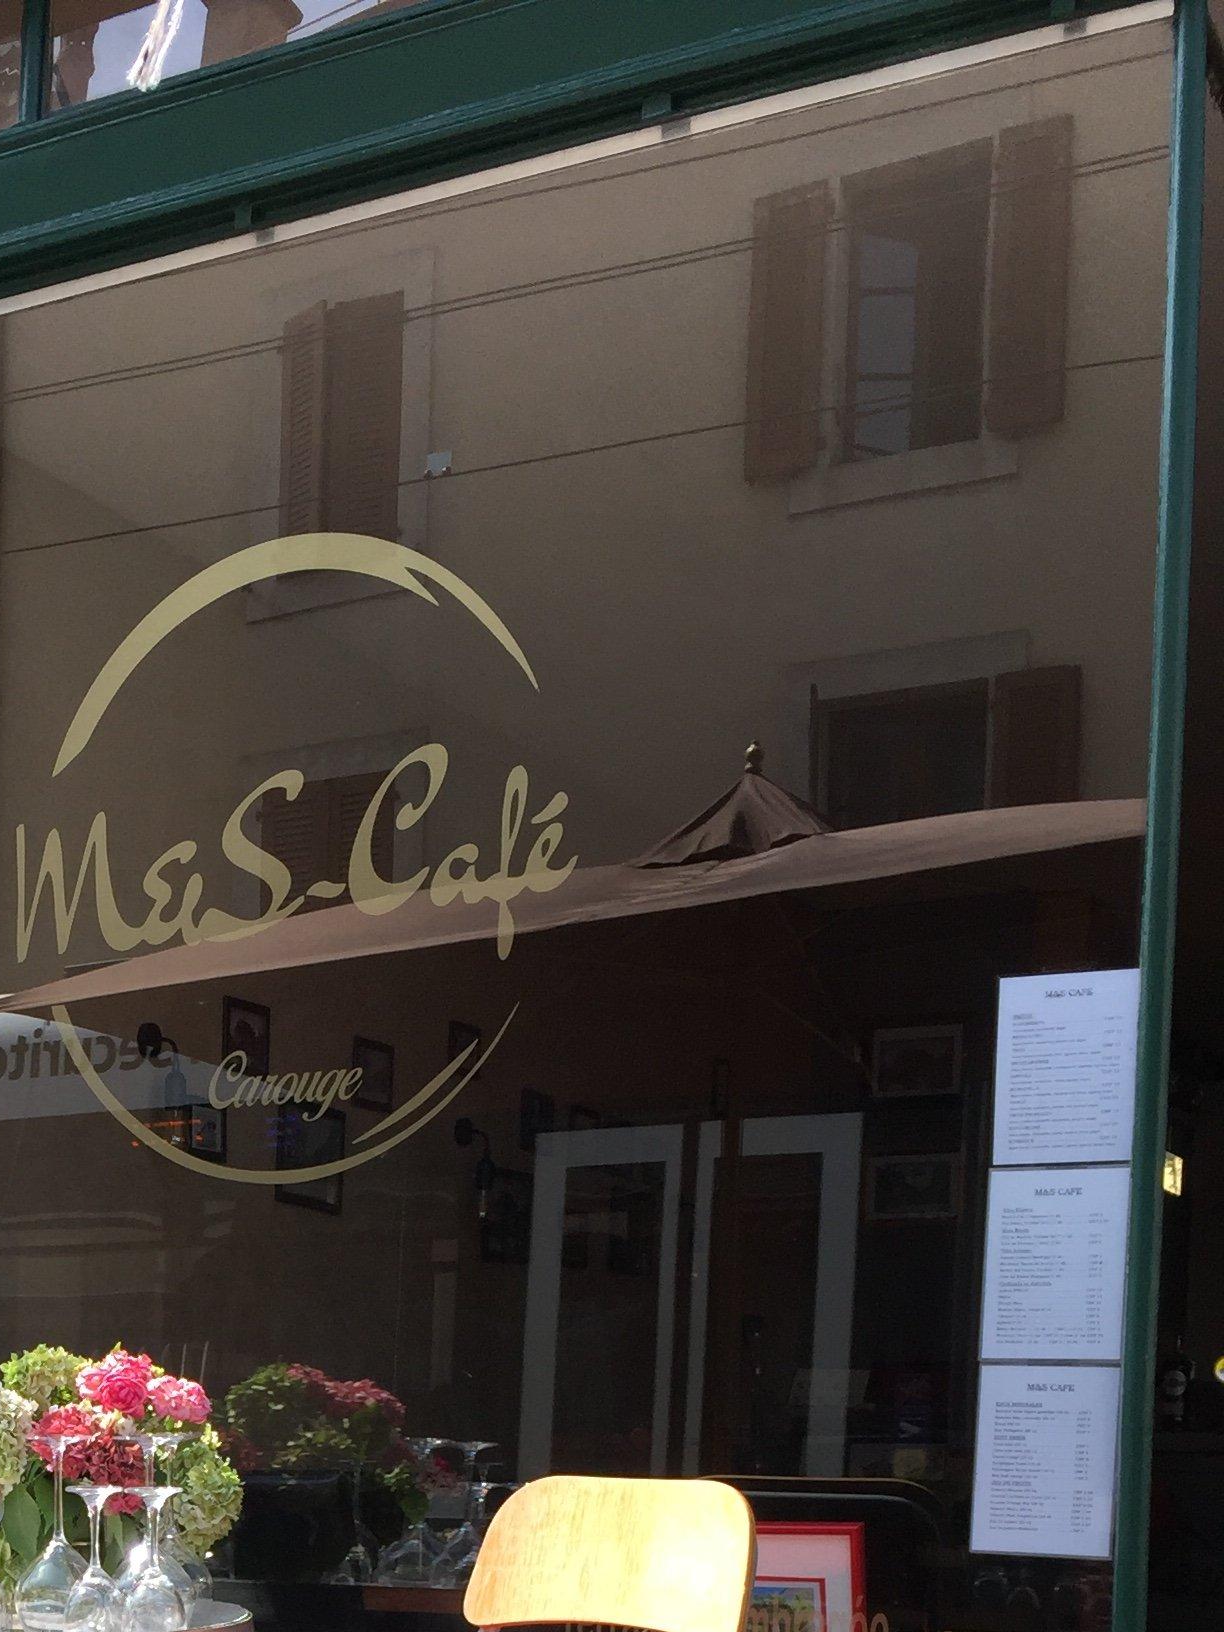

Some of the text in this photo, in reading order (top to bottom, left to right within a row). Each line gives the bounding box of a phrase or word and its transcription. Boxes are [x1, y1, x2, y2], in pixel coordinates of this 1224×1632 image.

[208, 1050, 364, 1122] Carouge
[1057, 1186, 1084, 1197] CAFE
[1049, 1383, 1075, 1393] CAFE
